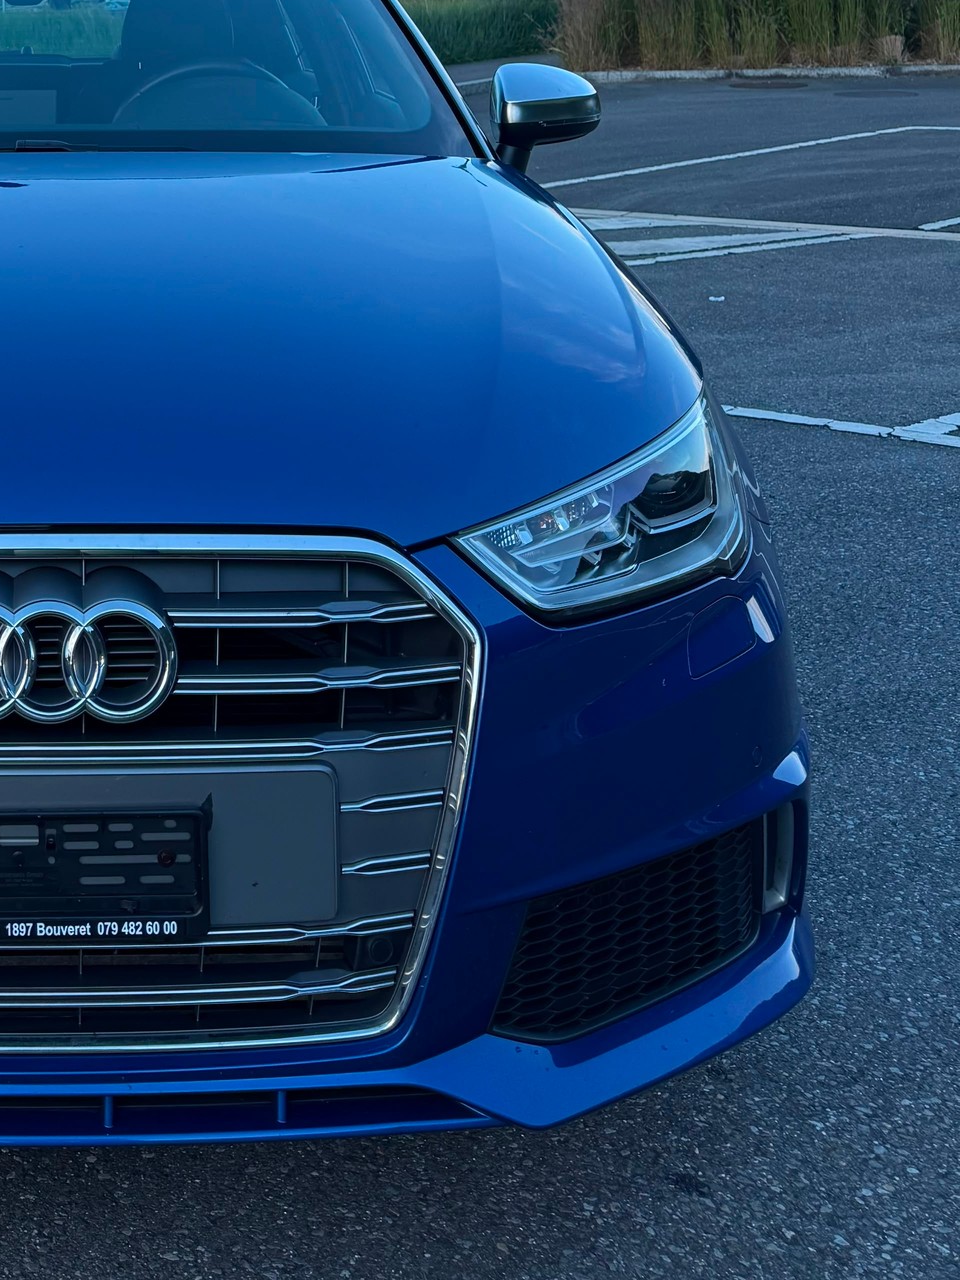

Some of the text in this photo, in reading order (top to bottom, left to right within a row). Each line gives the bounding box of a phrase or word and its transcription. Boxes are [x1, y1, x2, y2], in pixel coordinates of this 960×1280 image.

[5, 922, 33, 936] 1897
[36, 922, 91, 936] Bouveret
[97, 921, 118, 935] 079
[121, 921, 143, 935] 482
[145, 921, 160, 935] 60
[163, 920, 178, 934] 00
